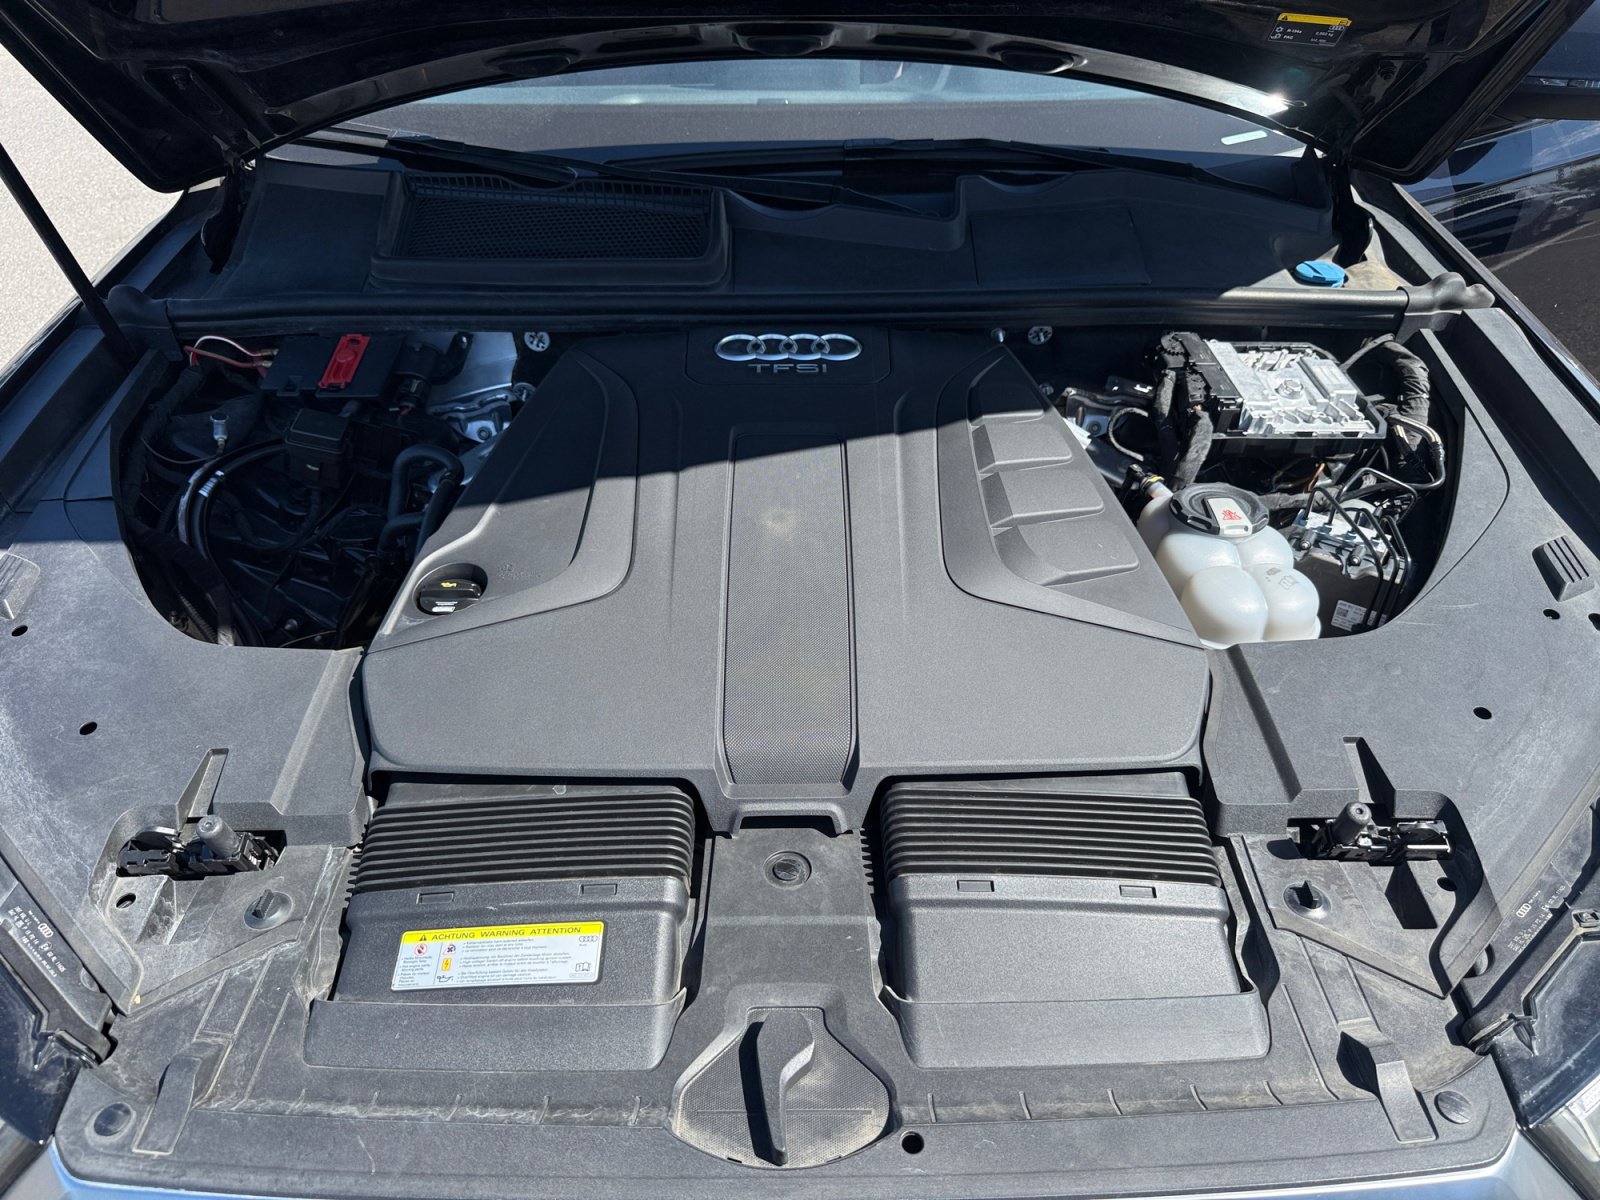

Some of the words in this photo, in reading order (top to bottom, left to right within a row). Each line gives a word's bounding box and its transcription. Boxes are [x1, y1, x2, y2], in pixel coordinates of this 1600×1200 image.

[748, 363, 828, 374] TFSI
[431, 932, 476, 941] ACHTUNG
[480, 929, 525, 938] WARNING
[529, 926, 582, 936] ATTENTION
